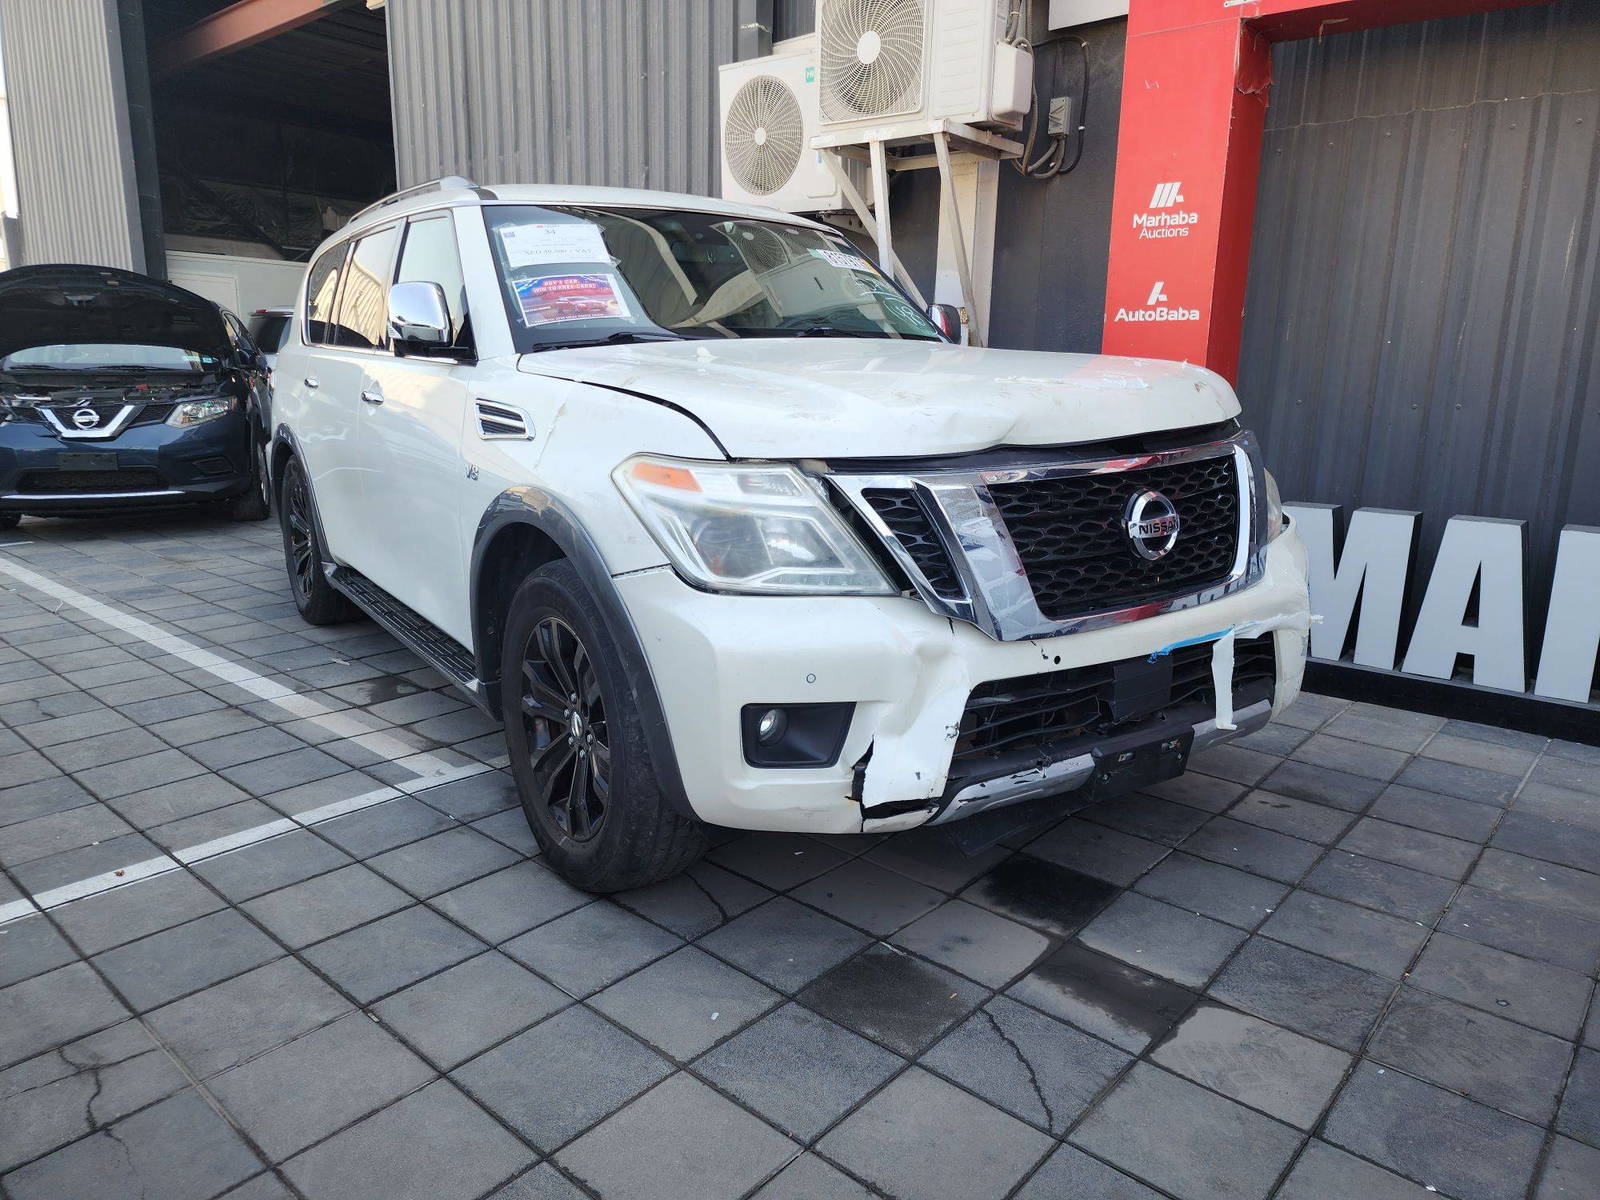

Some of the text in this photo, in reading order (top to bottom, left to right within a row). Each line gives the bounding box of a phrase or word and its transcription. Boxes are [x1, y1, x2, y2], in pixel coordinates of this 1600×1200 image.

[1133, 211, 1198, 228] Marhaba
[1139, 227, 1189, 240] Auctions
[1114, 306, 1200, 322] AutoBaba
